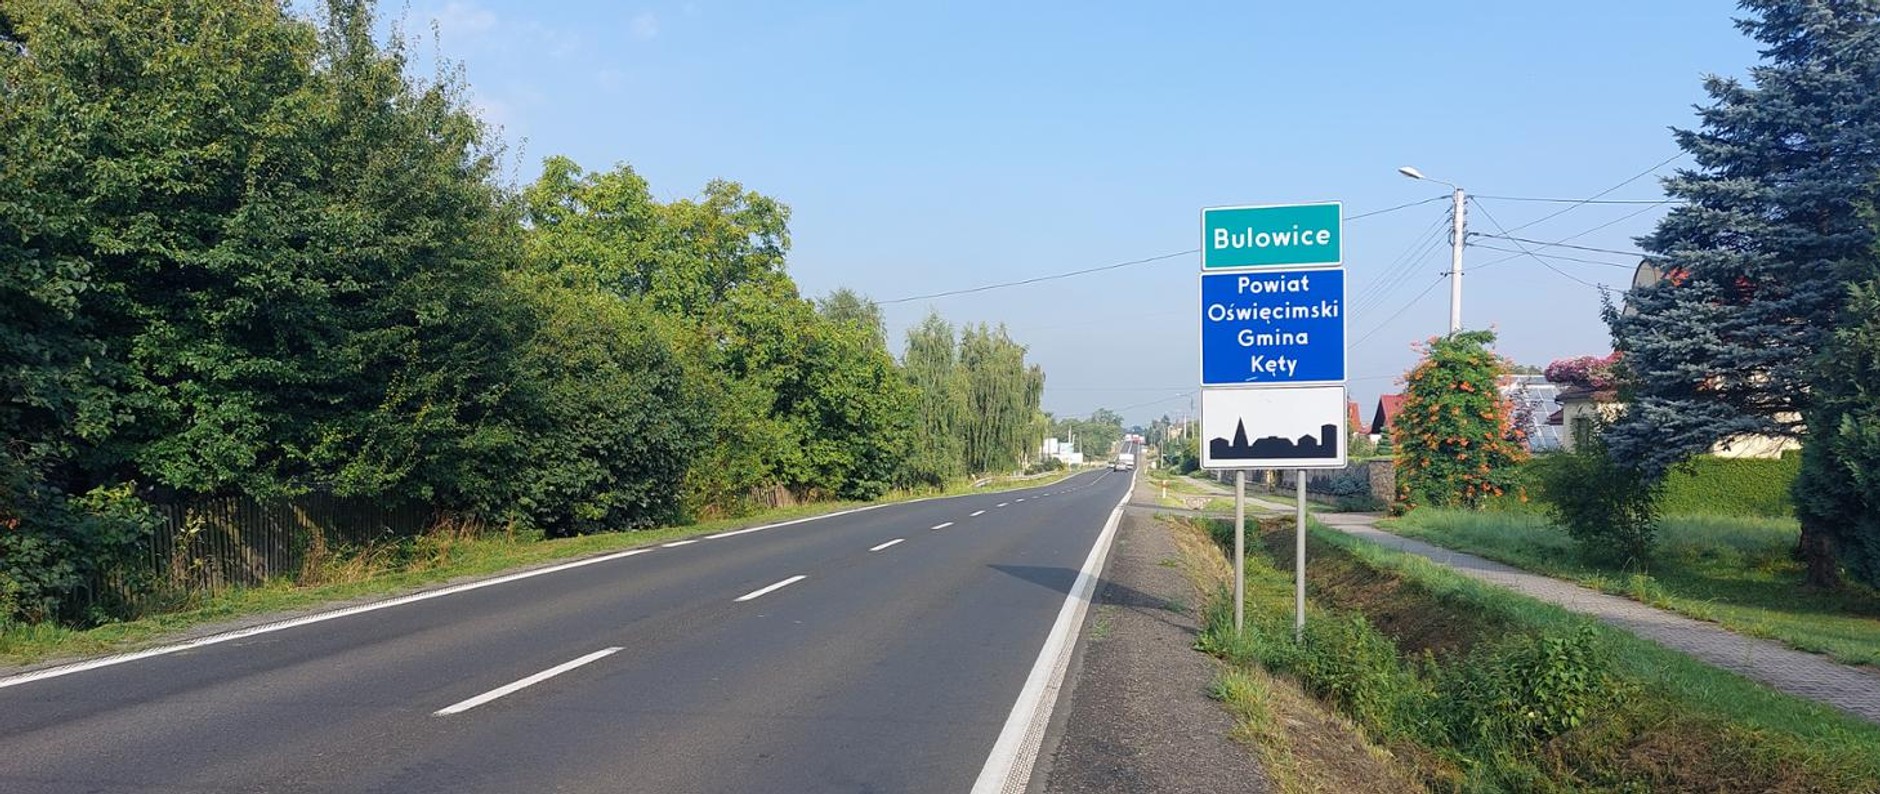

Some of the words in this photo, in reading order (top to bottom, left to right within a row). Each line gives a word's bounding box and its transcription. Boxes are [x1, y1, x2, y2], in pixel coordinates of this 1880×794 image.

[1213, 225, 1331, 249] Bulowice
[1237, 275, 1309, 294] Powiat
[1207, 300, 1338, 323] Oświęcimski
[1237, 328, 1309, 346] Gmina
[1251, 355, 1297, 377] Kęty
